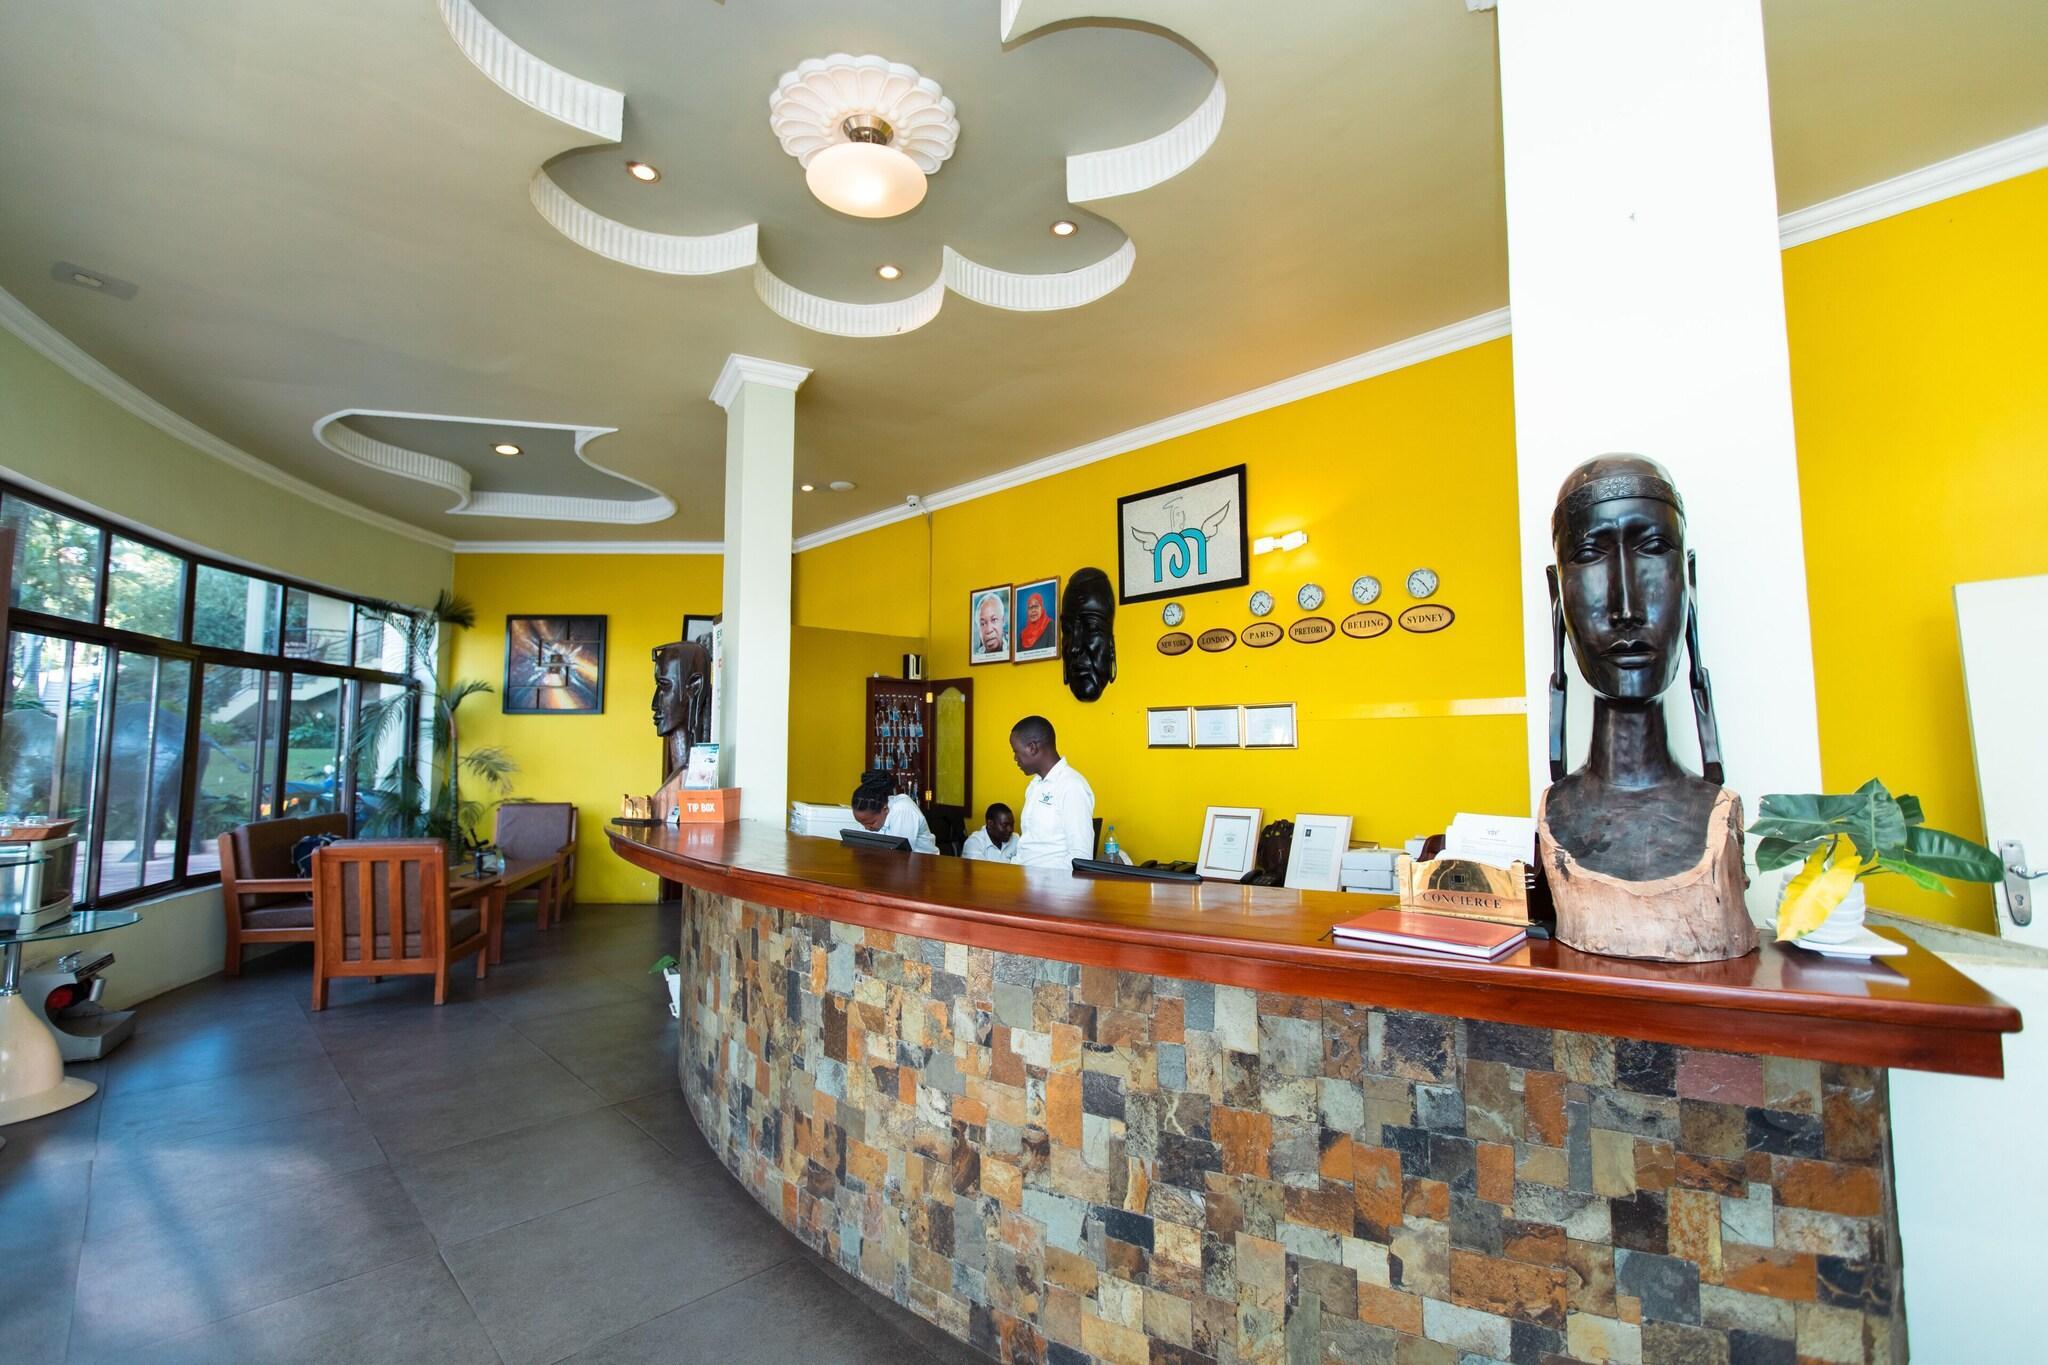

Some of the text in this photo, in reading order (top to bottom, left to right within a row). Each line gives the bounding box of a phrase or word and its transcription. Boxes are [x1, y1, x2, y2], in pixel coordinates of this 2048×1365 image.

[1407, 613, 1444, 624] SYDNEY
[1347, 619, 1384, 630] BEIJING
[1249, 630, 1274, 639] PARIS
[1294, 626, 1328, 635] PRETORIA
[1202, 635, 1230, 645] LONDON
[688, 803, 716, 813] TIP BOX
